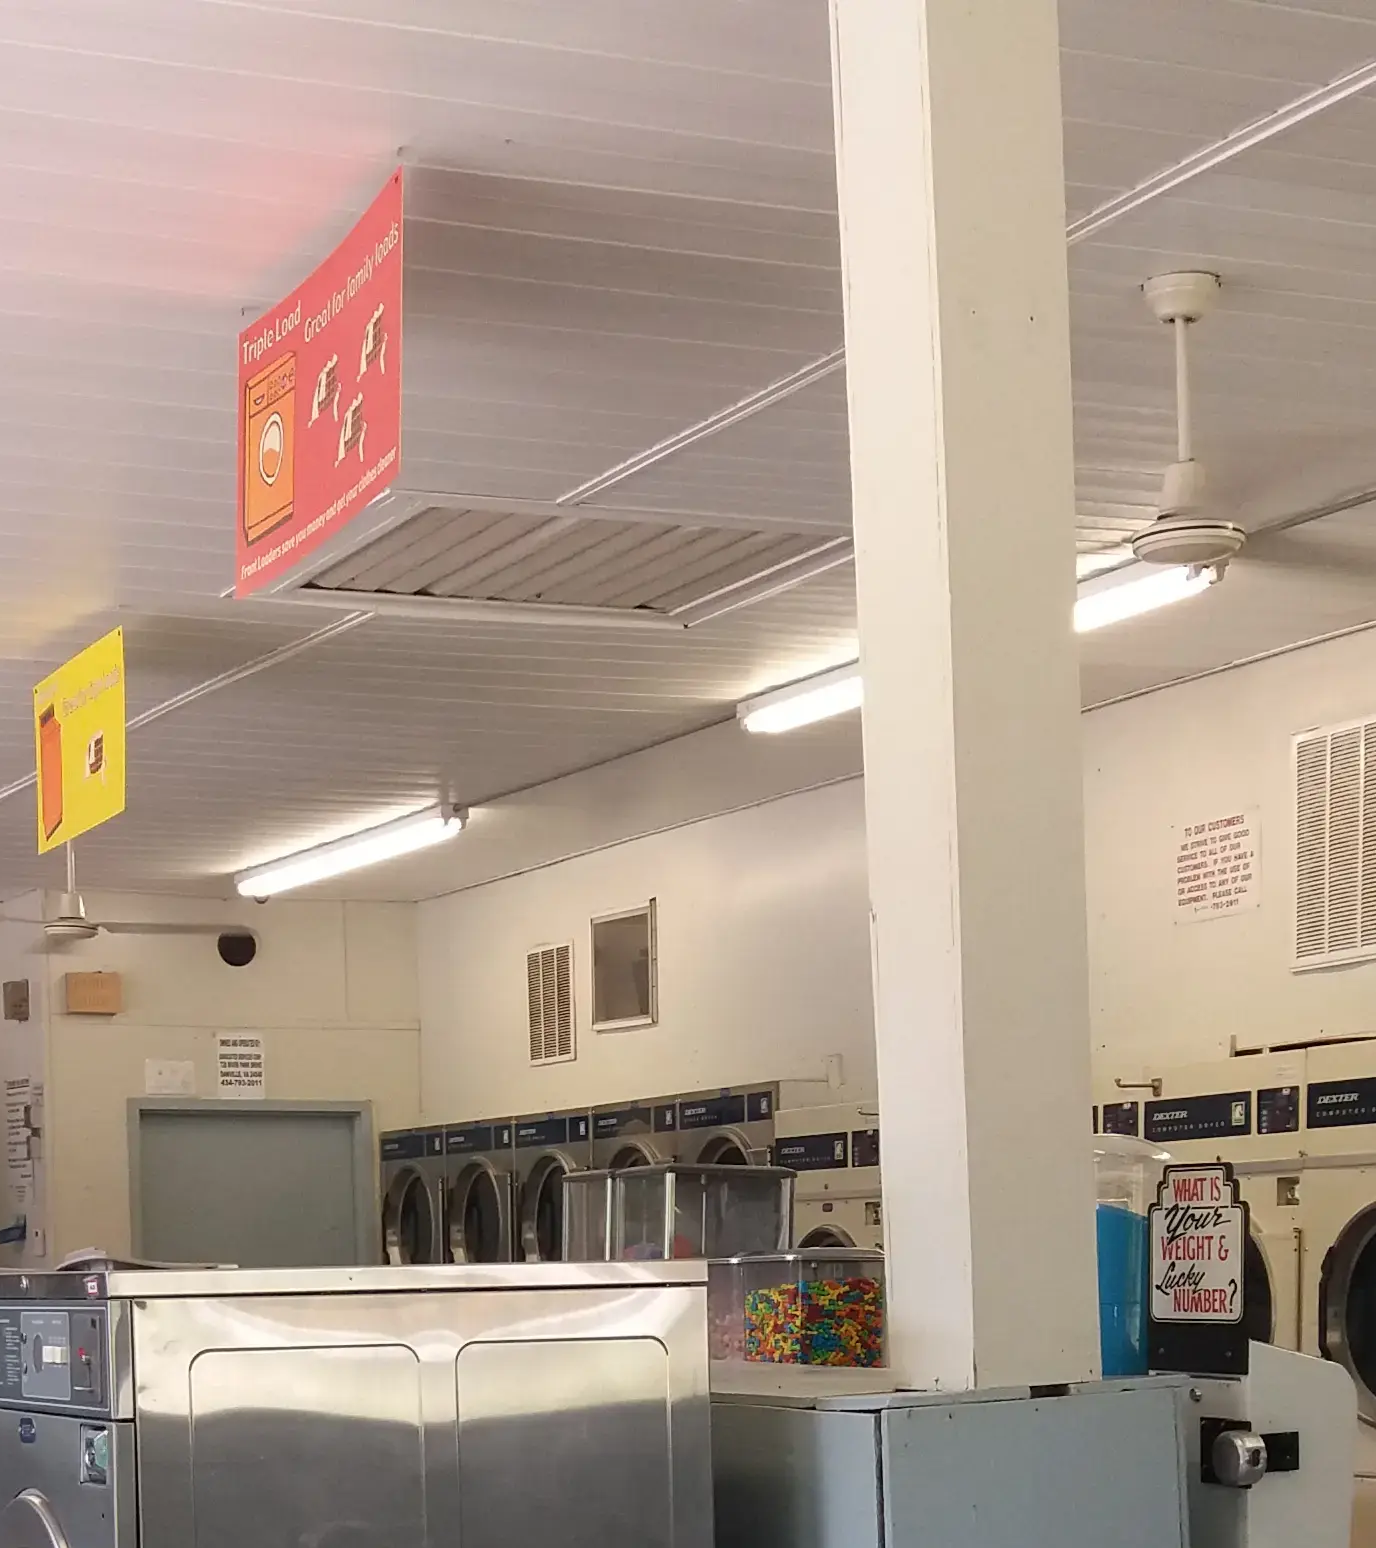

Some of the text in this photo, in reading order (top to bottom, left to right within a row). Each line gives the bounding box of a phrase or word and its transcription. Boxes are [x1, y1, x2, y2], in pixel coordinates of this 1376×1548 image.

[304, 221, 399, 343] Great for family loads
[242, 300, 301, 365] Triple Load
[240, 558, 258, 580] Front
[325, 499, 337, 521] and
[377, 447, 397, 476] cleaner
[1152, 1110, 1188, 1121] DEXTER
[1316, 1093, 1360, 1105] DEXTER
[1173, 1176, 1221, 1202] WHAT IS
[1164, 1203, 1231, 1246] Your
[1161, 1235, 1229, 1261] WEIGHT &
[1155, 1261, 1206, 1295] Lucky
